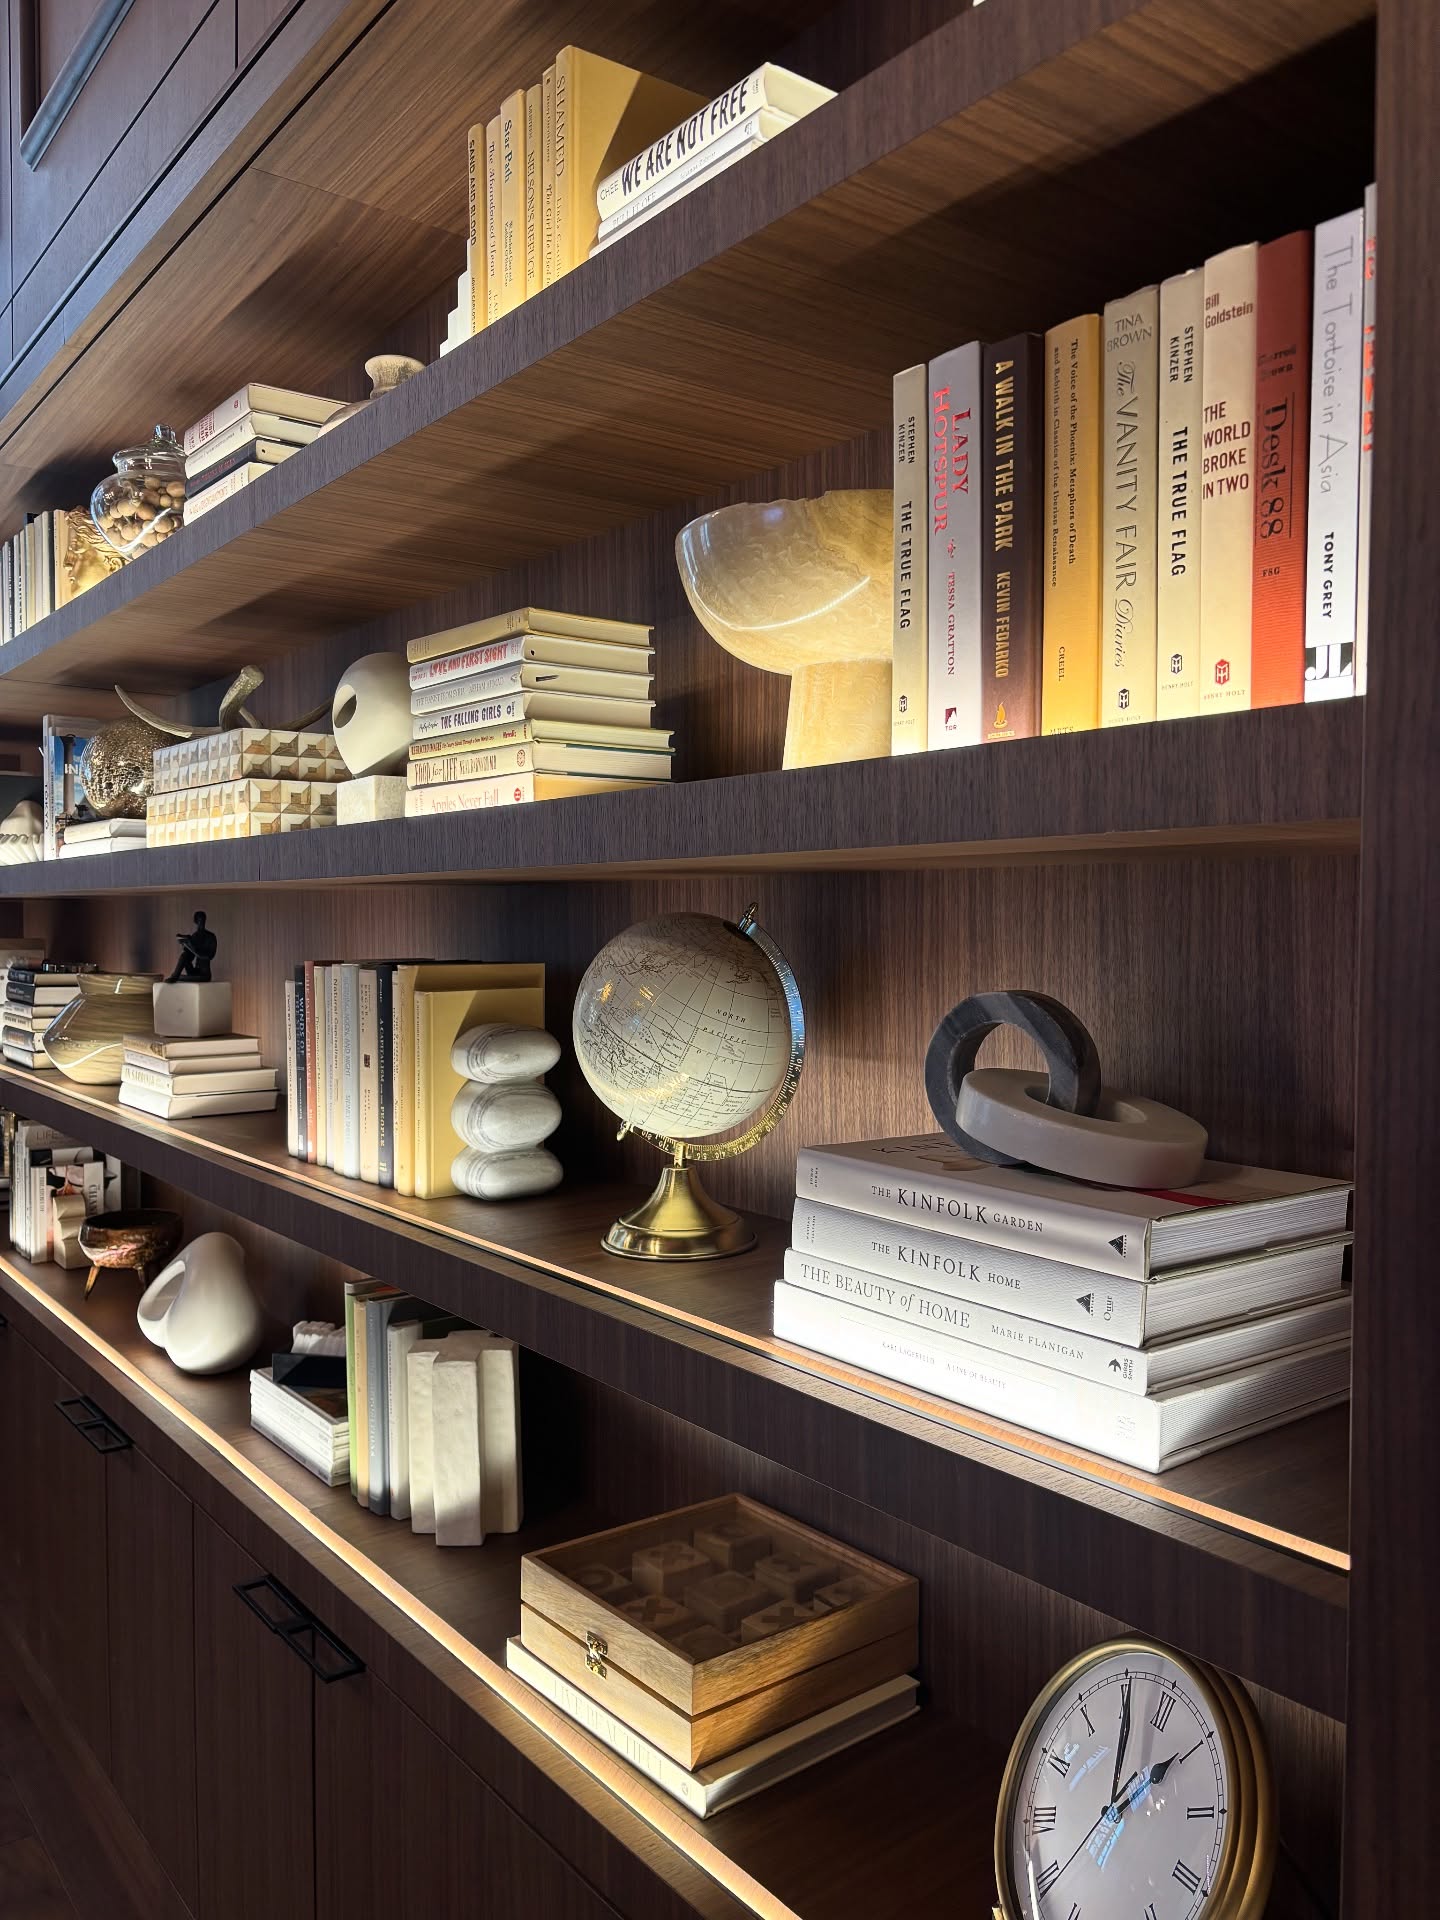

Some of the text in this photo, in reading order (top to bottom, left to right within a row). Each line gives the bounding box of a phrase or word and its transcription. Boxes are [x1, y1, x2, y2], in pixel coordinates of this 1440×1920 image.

[556, 74, 566, 177] SHAMED
[621, 154, 644, 197] WE
[645, 131, 675, 181] ARE
[676, 105, 710, 160] NOT
[710, 77, 751, 136] FREE
[487, 141, 496, 165] The
[503, 118, 515, 184] Star Path
[527, 151, 535, 222] NELSON'S
[600, 179, 619, 201] CHEE
[546, 234, 552, 250] He
[1114, 313, 1144, 334] TINA
[1204, 301, 1254, 330] Goldstein
[1205, 292, 1220, 312] Bill
[1053, 346, 1061, 365] and
[1106, 326, 1153, 352] BROWN
[1169, 335, 1179, 383] KINZER
[1184, 326, 1193, 384] STEPHEN
[1319, 235, 1354, 495] The Tortoise in Asia
[1203, 401, 1228, 424] THE
[1203, 420, 1251, 450] WORLD
[897, 423, 907, 464] KINZER
[906, 416, 916, 465] STEPHEN
[932, 386, 952, 537] HOTSPUR
[950, 406, 972, 496] LADY
[994, 359, 1014, 553] A WALK IN THE PARK
[1068, 338, 1079, 565] The Voice of the Phoenix: Metaphors of Death
[1114, 394, 1139, 513] VANITY
[1203, 447, 1248, 475] BROKE
[1202, 474, 1250, 500] IN TWO
[1260, 402, 1288, 539] Desk 88
[1171, 426, 1188, 577] THE TRUE FLAG
[899, 500, 913, 630] THE TRUE FLAG
[1051, 528, 1059, 588] Renaissance
[1114, 526, 1138, 592] FAIR
[1321, 531, 1335, 619] TONY GREY
[946, 571, 956, 677] TESSA GRATTON
[994, 571, 1012, 679] KEVIN FEDARKO
[1113, 596, 1135, 669] Diaries
[429, 659, 448, 678] LOVE
[461, 649, 485, 670] FIRST
[484, 643, 509, 664] SIGHT
[1057, 646, 1066, 682] CREEL
[441, 716, 452, 730] THE
[453, 708, 479, 728] FALLING
[481, 704, 502, 722] GIRLS
[442, 757, 458, 782] LIFE
[457, 791, 481, 810] Never
[702, 1027, 747, 1045] PACIFIC
[715, 1009, 747, 1024] NORTH
[871, 1185, 1044, 1233] THE KINFOLK GARDEN
[871, 1241, 1021, 1290] THE KINFOLK HOME
[801, 1263, 971, 1329] THE BEAUTY of HOME
[991, 1324, 1084, 1360] MARIE FLANIGAN
[898, 1345, 935, 1366] LAGERFELD
[979, 1372, 1007, 1390] BEAUTY
[1031, 1805, 1057, 1835] VIII
[1186, 1804, 1215, 1820] II
[1171, 1859, 1202, 1896] III
